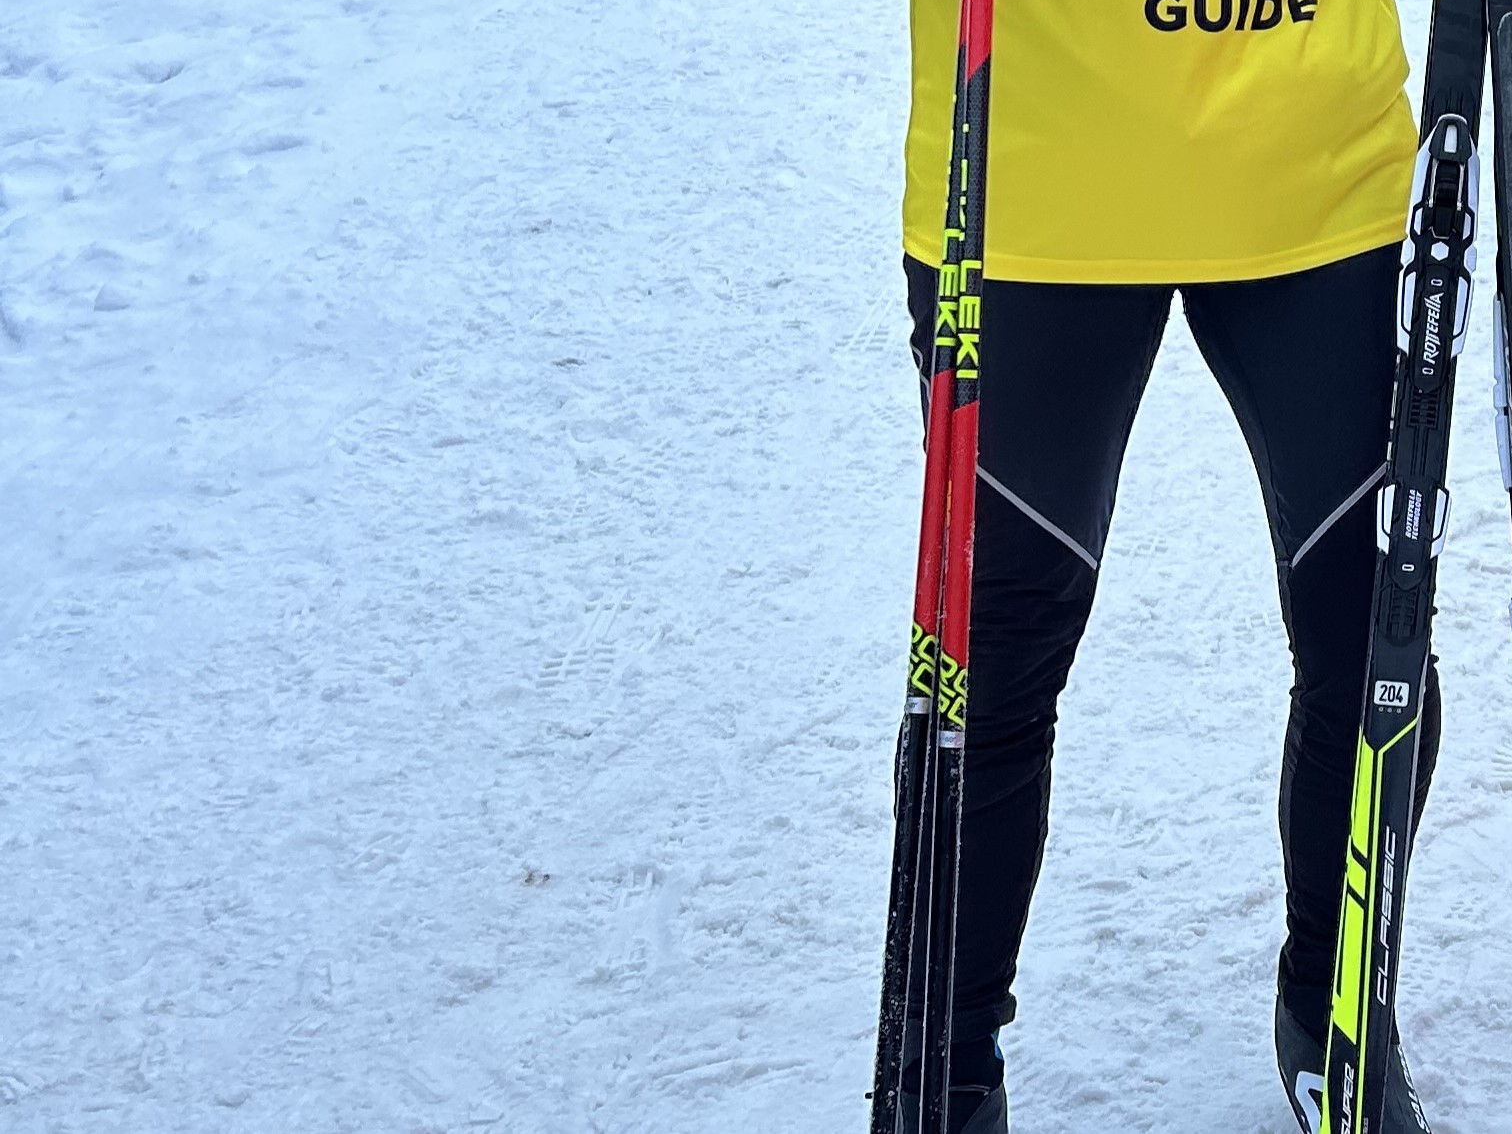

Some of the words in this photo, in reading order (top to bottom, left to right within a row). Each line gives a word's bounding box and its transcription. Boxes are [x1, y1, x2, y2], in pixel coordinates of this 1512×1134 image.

[935, 228, 963, 347] LEKI
[956, 260, 983, 380] LEKI
[1379, 684, 1404, 703] 204
[1376, 826, 1396, 1006] CLASSIC
